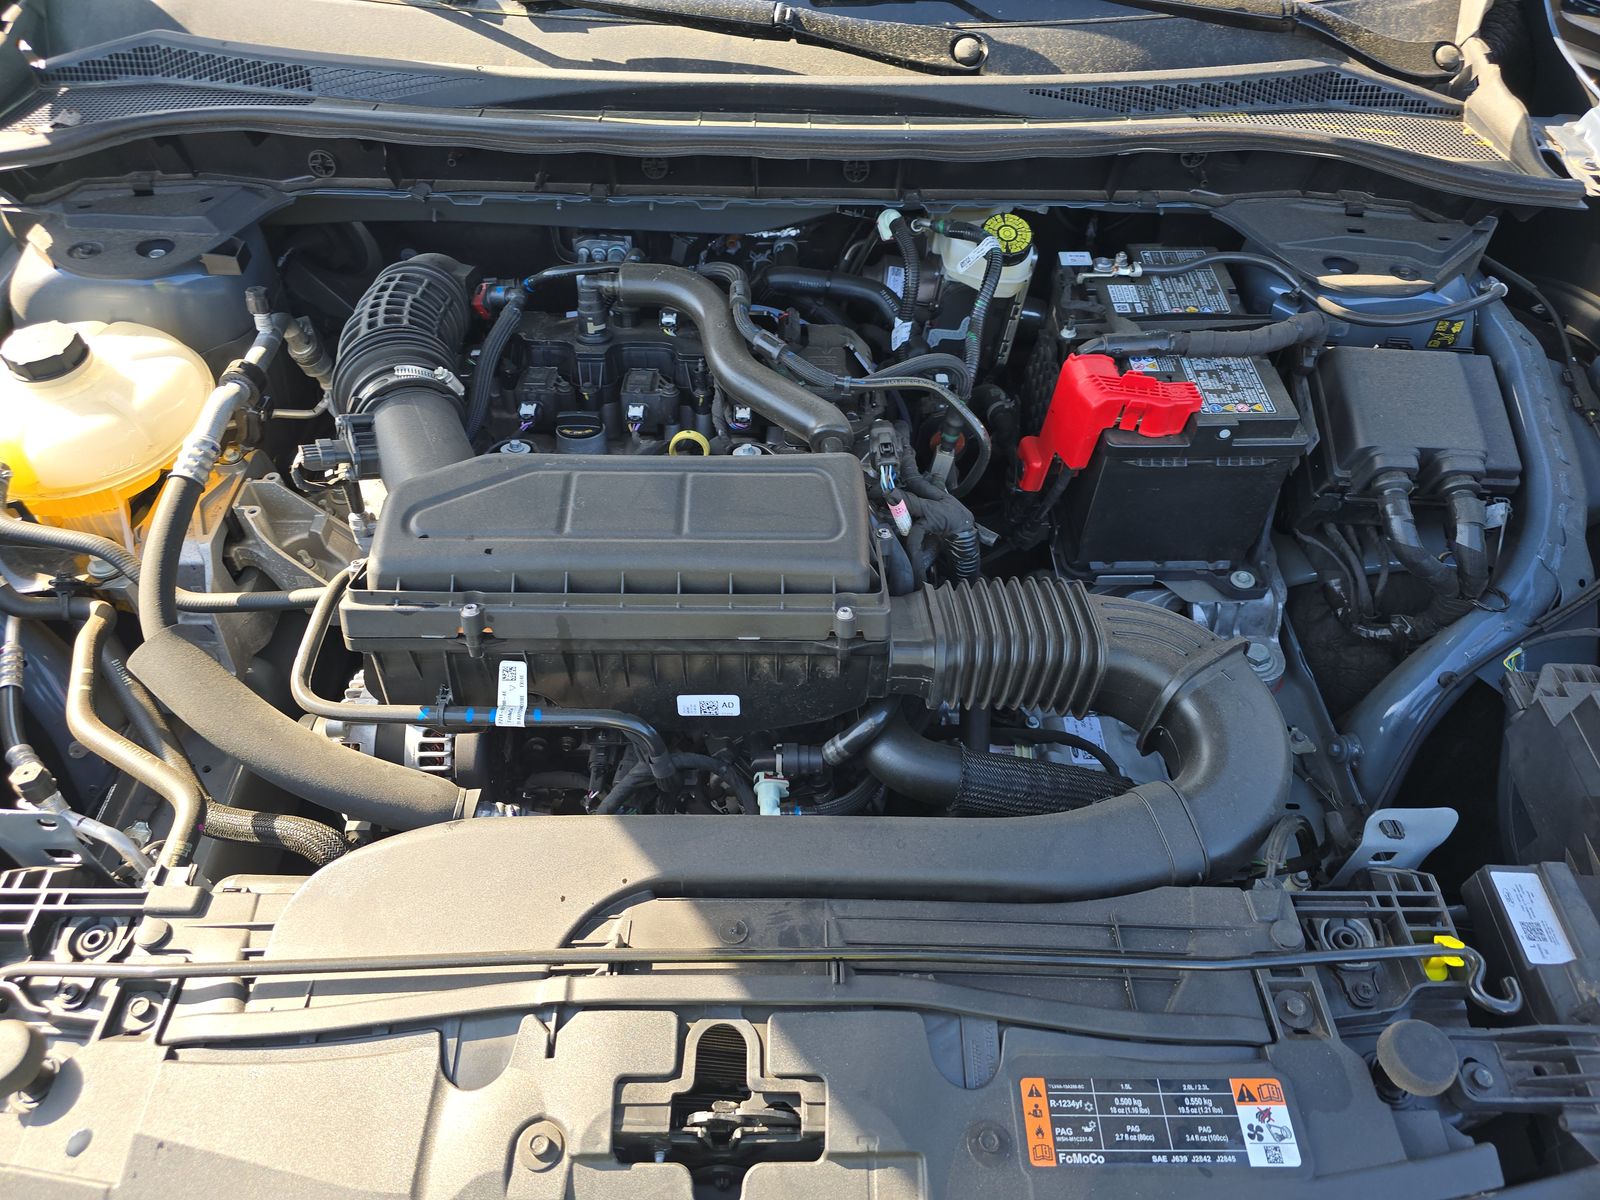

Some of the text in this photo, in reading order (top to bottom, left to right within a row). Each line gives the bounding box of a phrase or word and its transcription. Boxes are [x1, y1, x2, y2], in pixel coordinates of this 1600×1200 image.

[721, 701, 735, 709] AD
[1049, 1100, 1083, 1109] R-1234yf
[1114, 1098, 1143, 1107] 0.500 kg
[1184, 1098, 1213, 1107] 0.550 kg
[1055, 1128, 1073, 1136] PAG
[1058, 1152, 1105, 1164] FoMoCo
